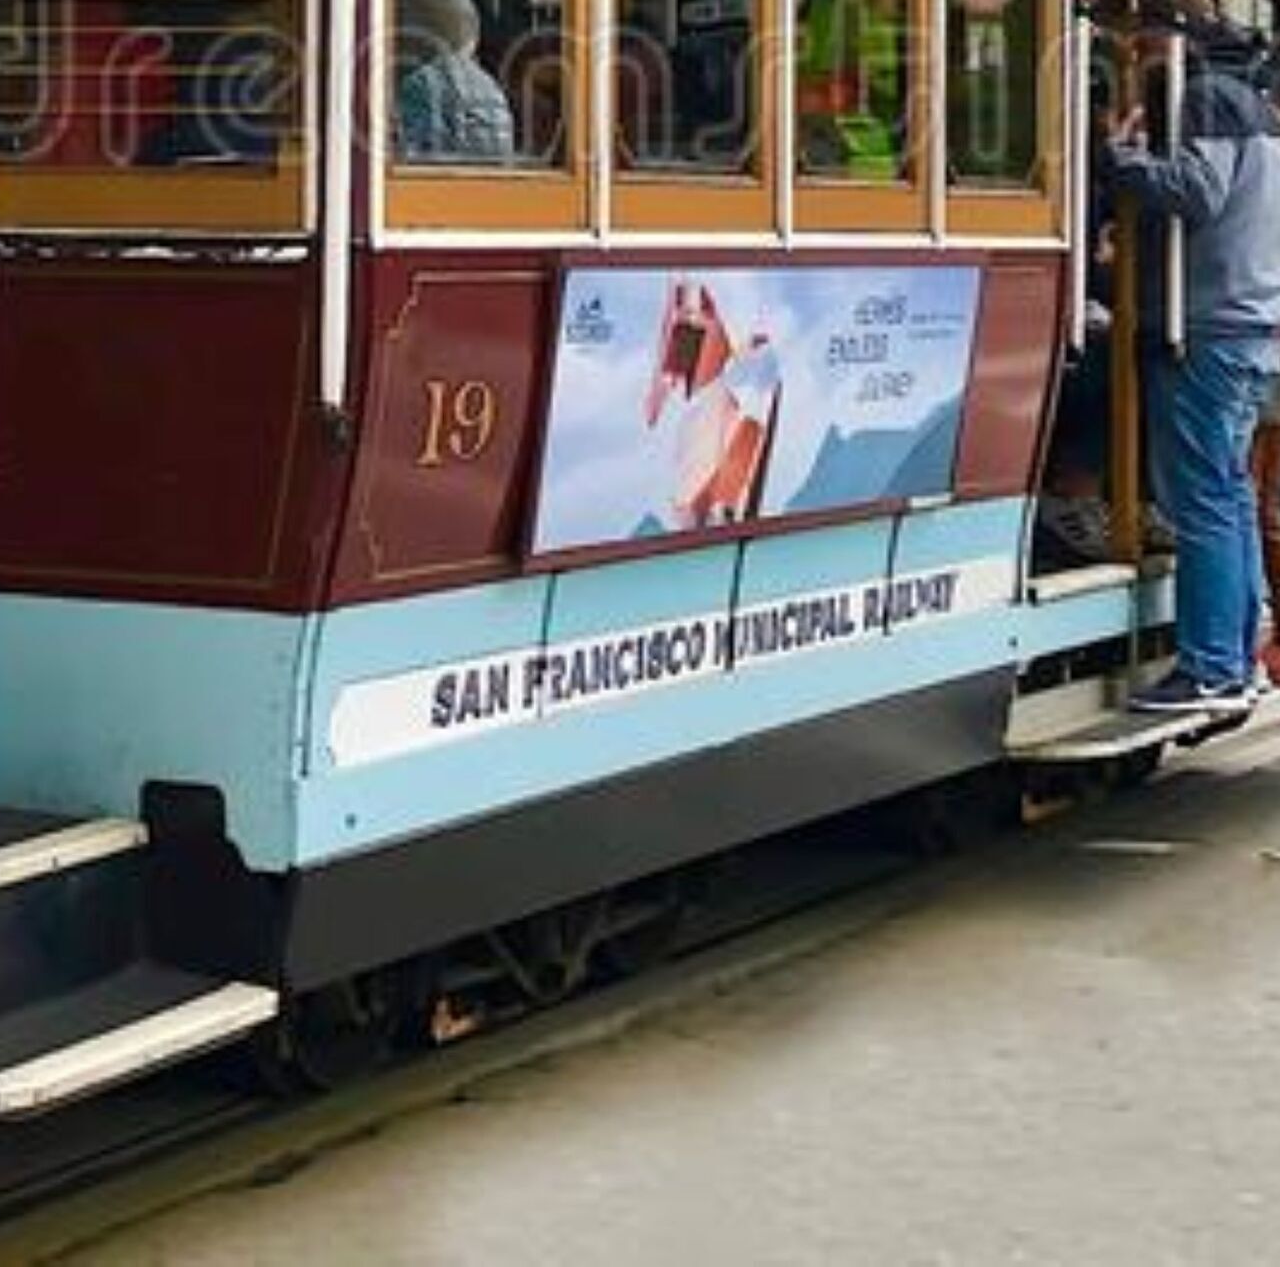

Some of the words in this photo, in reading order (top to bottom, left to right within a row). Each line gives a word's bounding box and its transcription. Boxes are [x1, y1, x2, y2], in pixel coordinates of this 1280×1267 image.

[417, 378, 499, 467] 19
[430, 663, 510, 728] SAN
[520, 621, 706, 709] FRANCISCO
[714, 599, 855, 668] MUNICIPAL
[862, 572, 960, 633] RAILWAY
